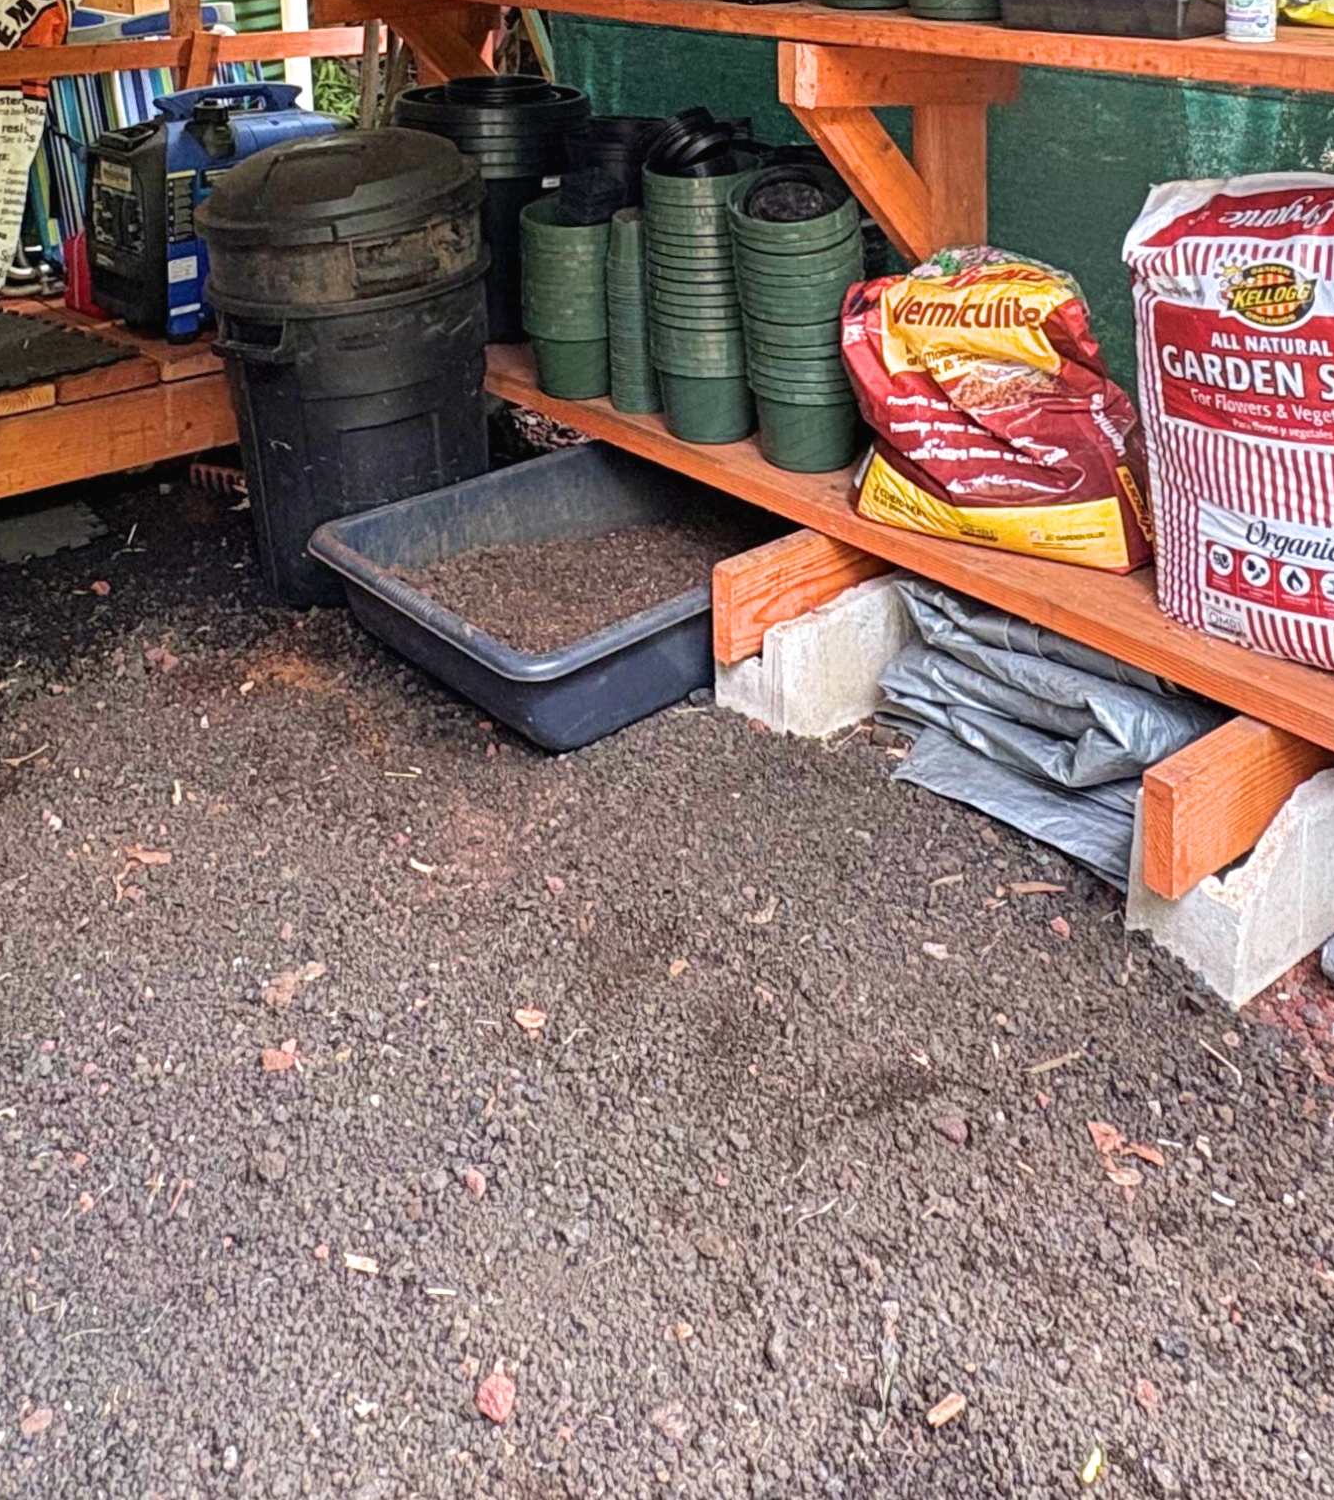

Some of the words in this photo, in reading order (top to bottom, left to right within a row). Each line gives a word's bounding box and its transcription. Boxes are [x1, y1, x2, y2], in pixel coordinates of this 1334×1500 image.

[1232, 281, 1314, 309] KELLOGG
[893, 297, 1042, 331] Vermiculite
[1211, 332, 1240, 350] ALL
[1245, 335, 1334, 357] NATURAL
[1161, 344, 1305, 398] GARDEN
[1190, 388, 1212, 406] For
[1214, 393, 1271, 418] Flowers
[1275, 405, 1288, 419] &
[1288, 428, 1334, 441] vegetales
[930, 447, 968, 461] Potting
[1003, 451, 1014, 460] or
